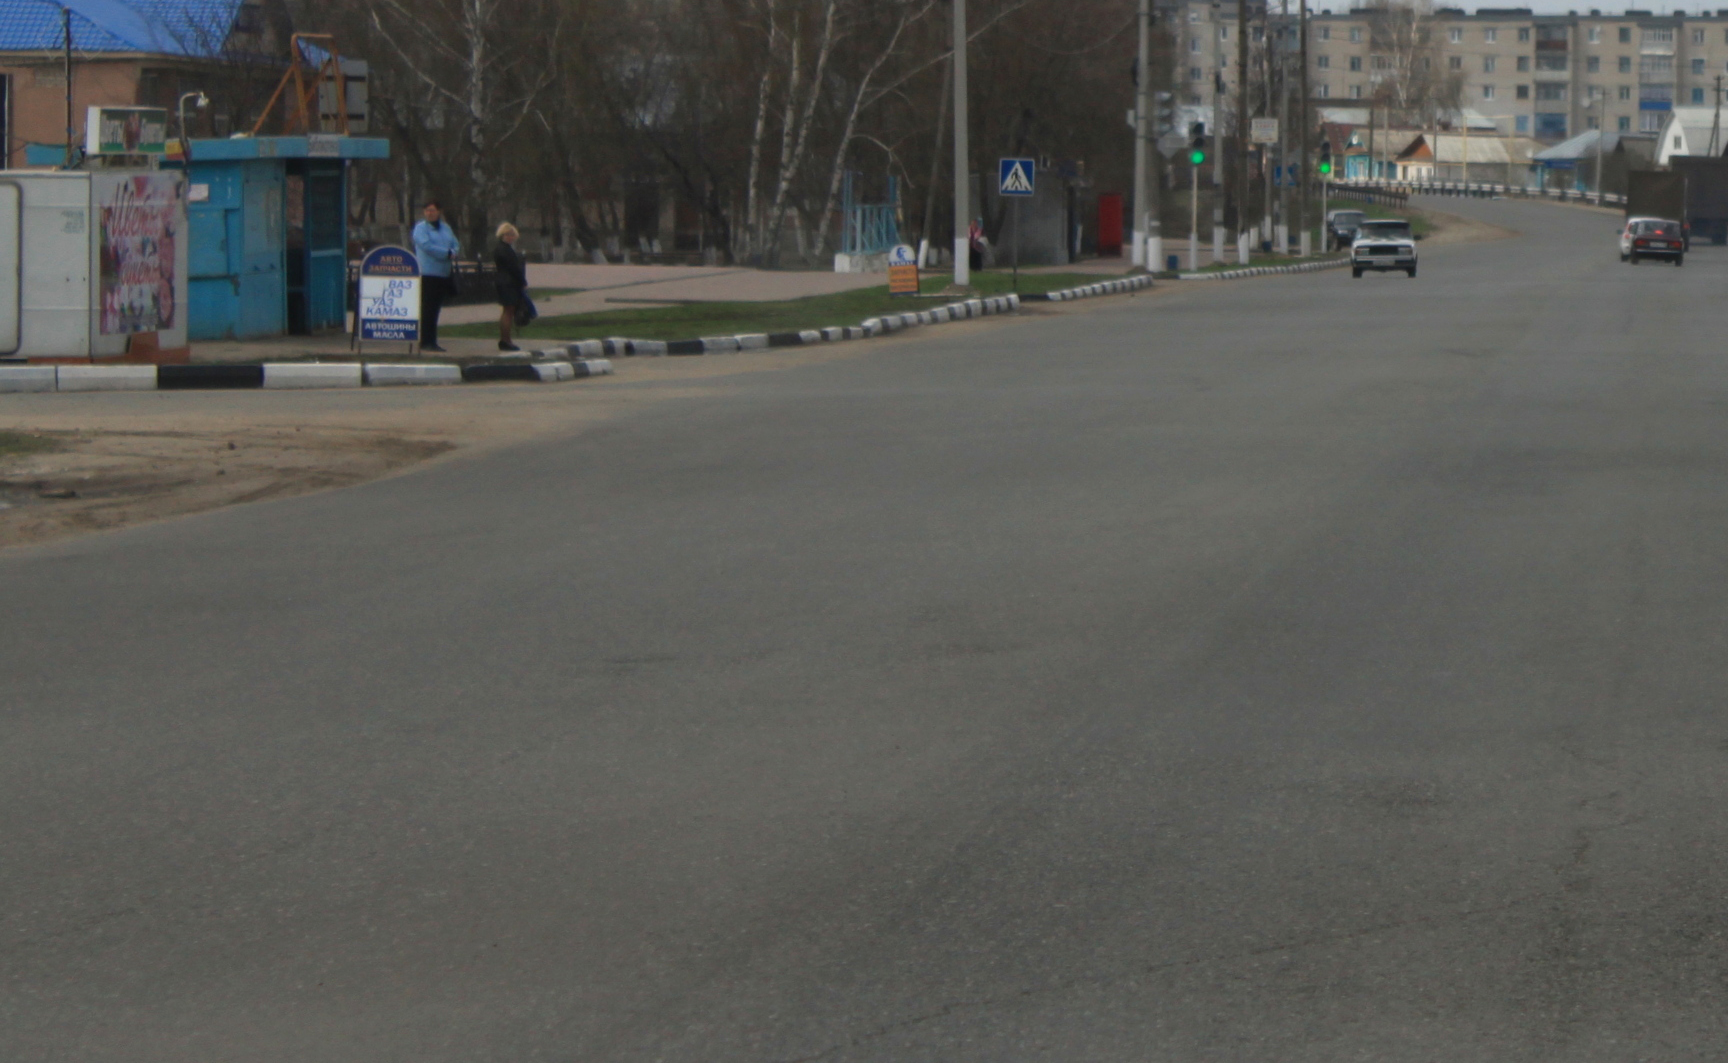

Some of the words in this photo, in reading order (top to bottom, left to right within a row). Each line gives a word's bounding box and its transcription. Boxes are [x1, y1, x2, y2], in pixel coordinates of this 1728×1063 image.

[389, 280, 412, 289] ВАЗ
[372, 298, 394, 307] УАЗ
[366, 307, 407, 316] КАМАЗ
[365, 322, 415, 330] АВТОШИНЫ
